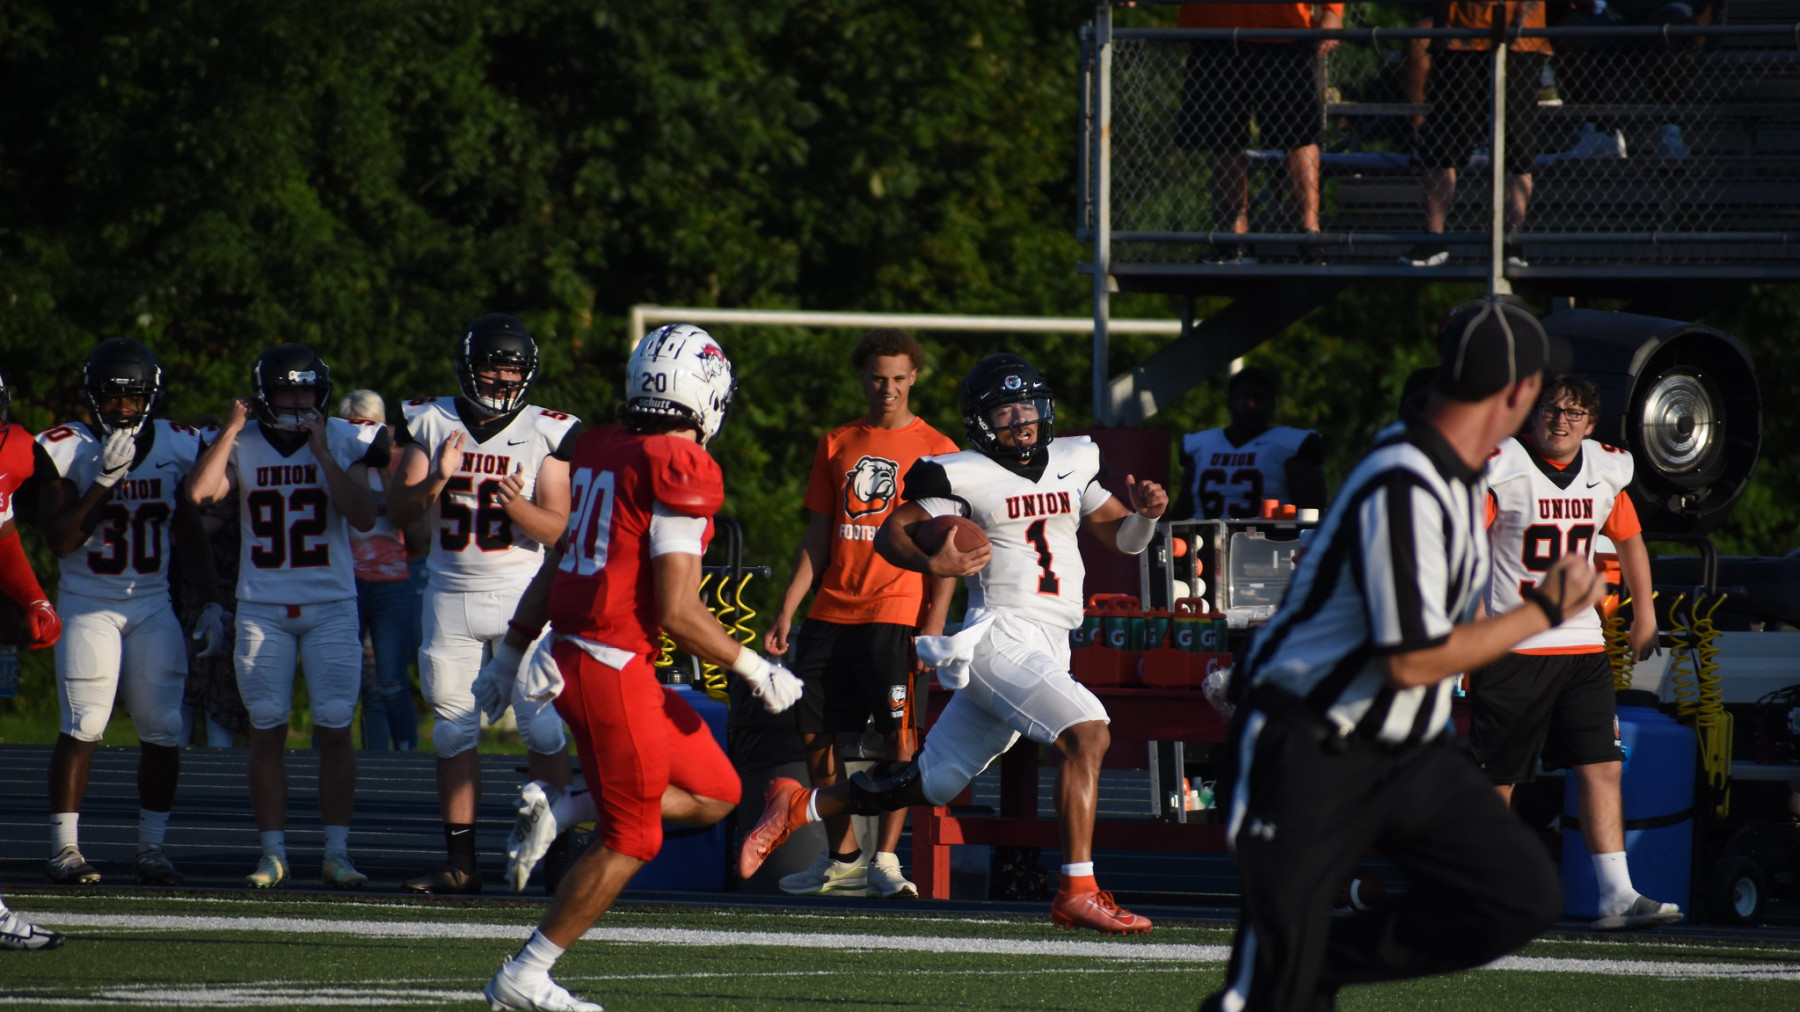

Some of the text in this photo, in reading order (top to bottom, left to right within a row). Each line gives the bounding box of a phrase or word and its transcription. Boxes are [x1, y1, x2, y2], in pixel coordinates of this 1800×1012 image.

[642, 371, 667, 393] 20
[460, 451, 511, 476] NION
[1210, 452, 1257, 466] UNION
[256, 464, 318, 487] UNION
[1005, 491, 1072, 519] UNION
[1198, 469, 1264, 520] 63
[1538, 498, 1594, 519] UNION
[247, 487, 331, 569] 92
[558, 467, 616, 576] 20
[839, 523, 881, 542] FOOTB
[87, 502, 171, 575] 30
[1025, 518, 1061, 597] 1
[1110, 629, 1125, 646] G
[1178, 629, 1192, 646] G
